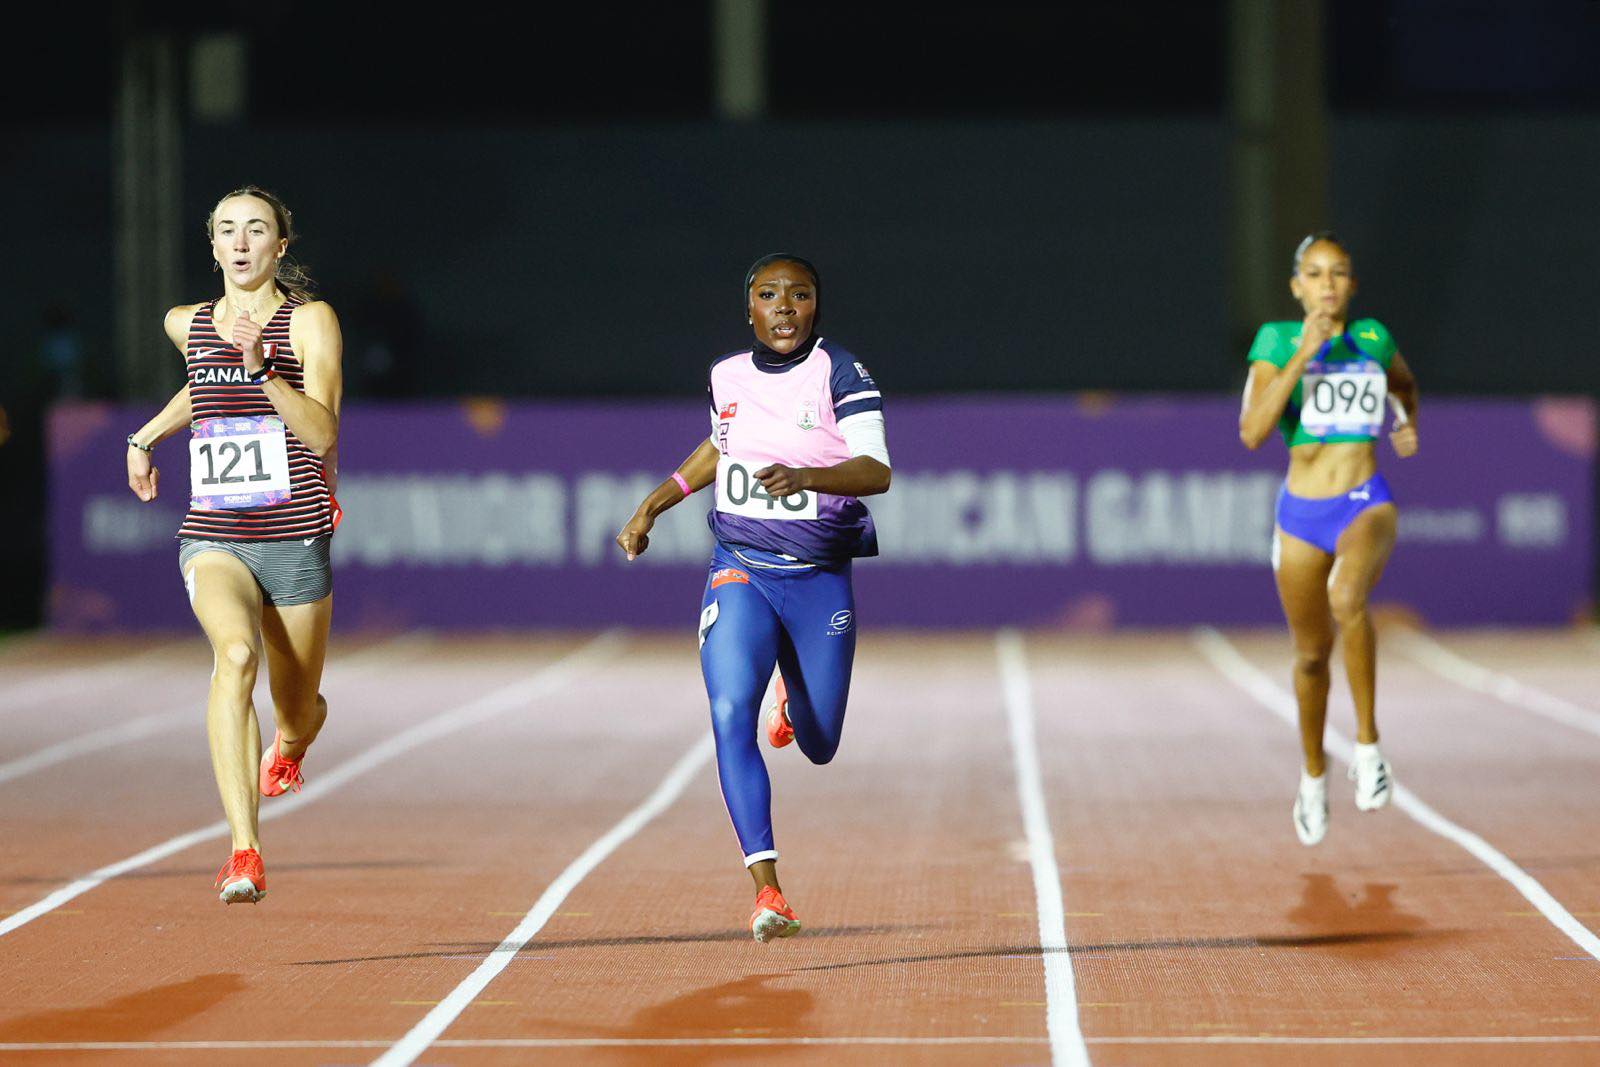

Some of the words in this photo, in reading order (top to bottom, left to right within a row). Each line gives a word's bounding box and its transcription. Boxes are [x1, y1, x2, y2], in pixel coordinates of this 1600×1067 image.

[194, 367, 252, 384] CANA
[1313, 379, 1378, 414] 096
[199, 439, 272, 485] 121
